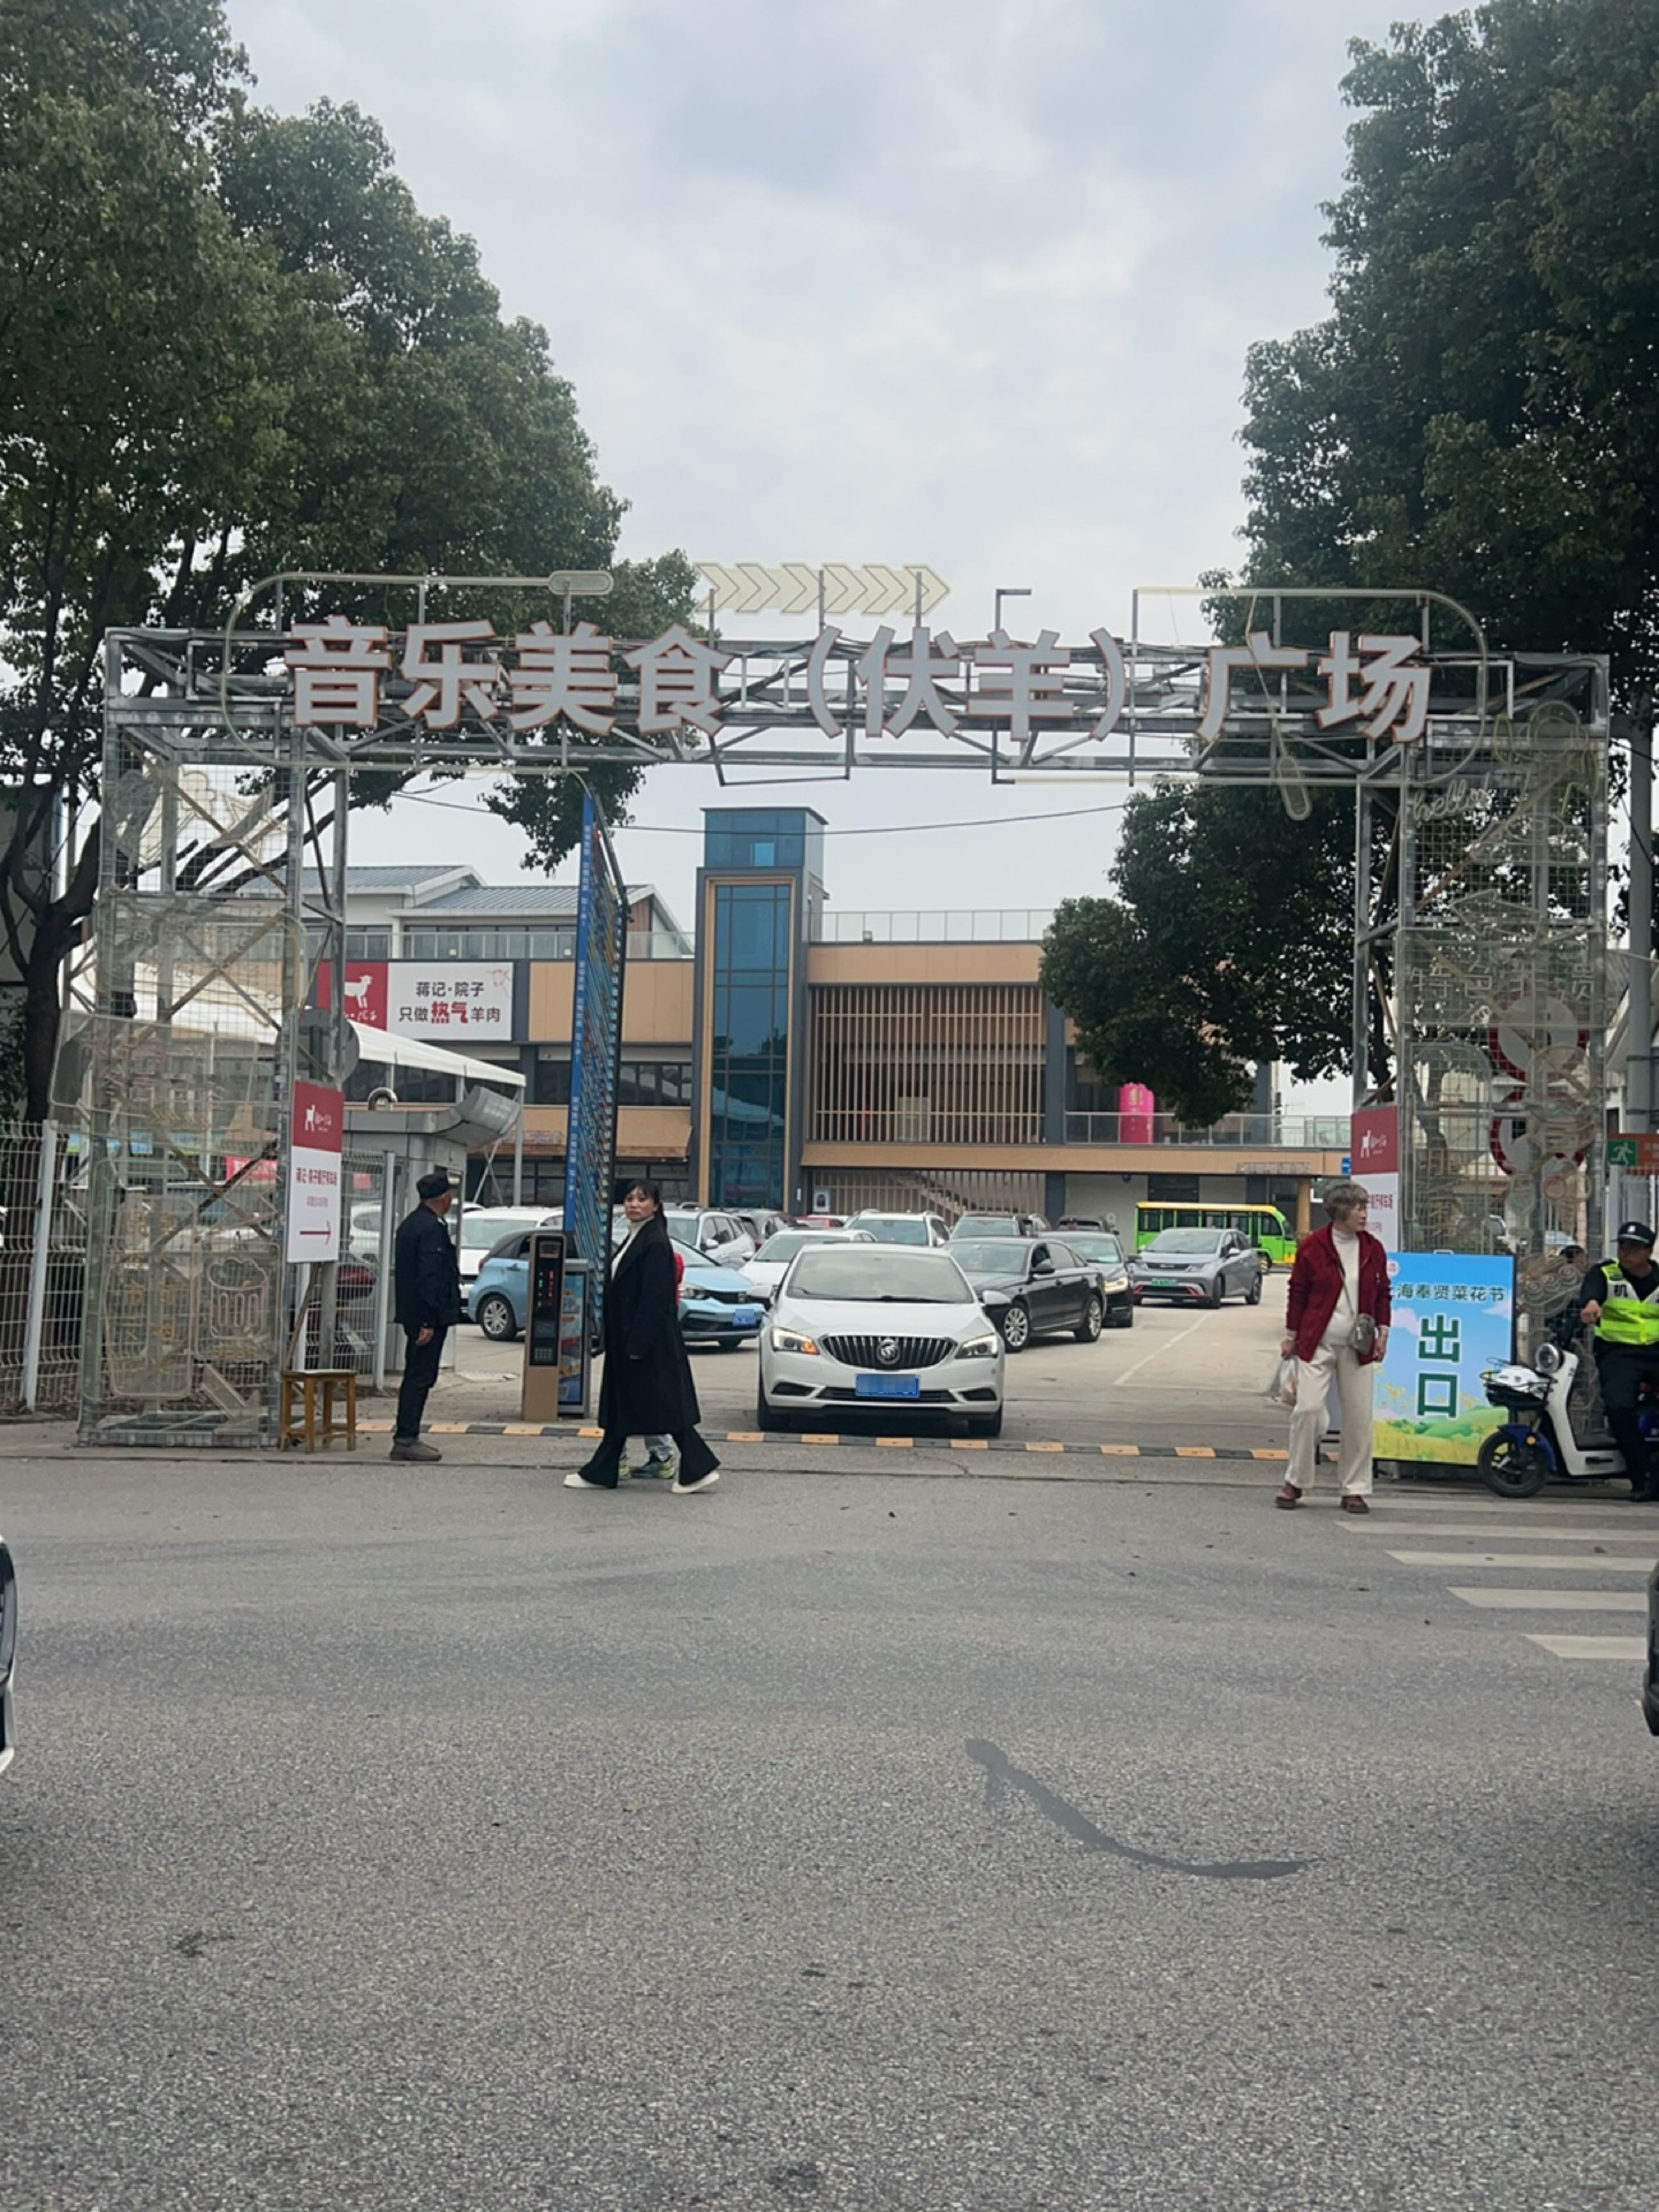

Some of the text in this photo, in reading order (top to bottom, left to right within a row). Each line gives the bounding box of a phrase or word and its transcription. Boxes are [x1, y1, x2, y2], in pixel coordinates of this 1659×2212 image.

[284, 615, 1432, 744] 音乐美食（伏羊）广场
[399, 1000, 501, 1024] 只做热气羊肉
[415, 981, 485, 997] 蒋记·院子
[1416, 1313, 1460, 1418] 出口
